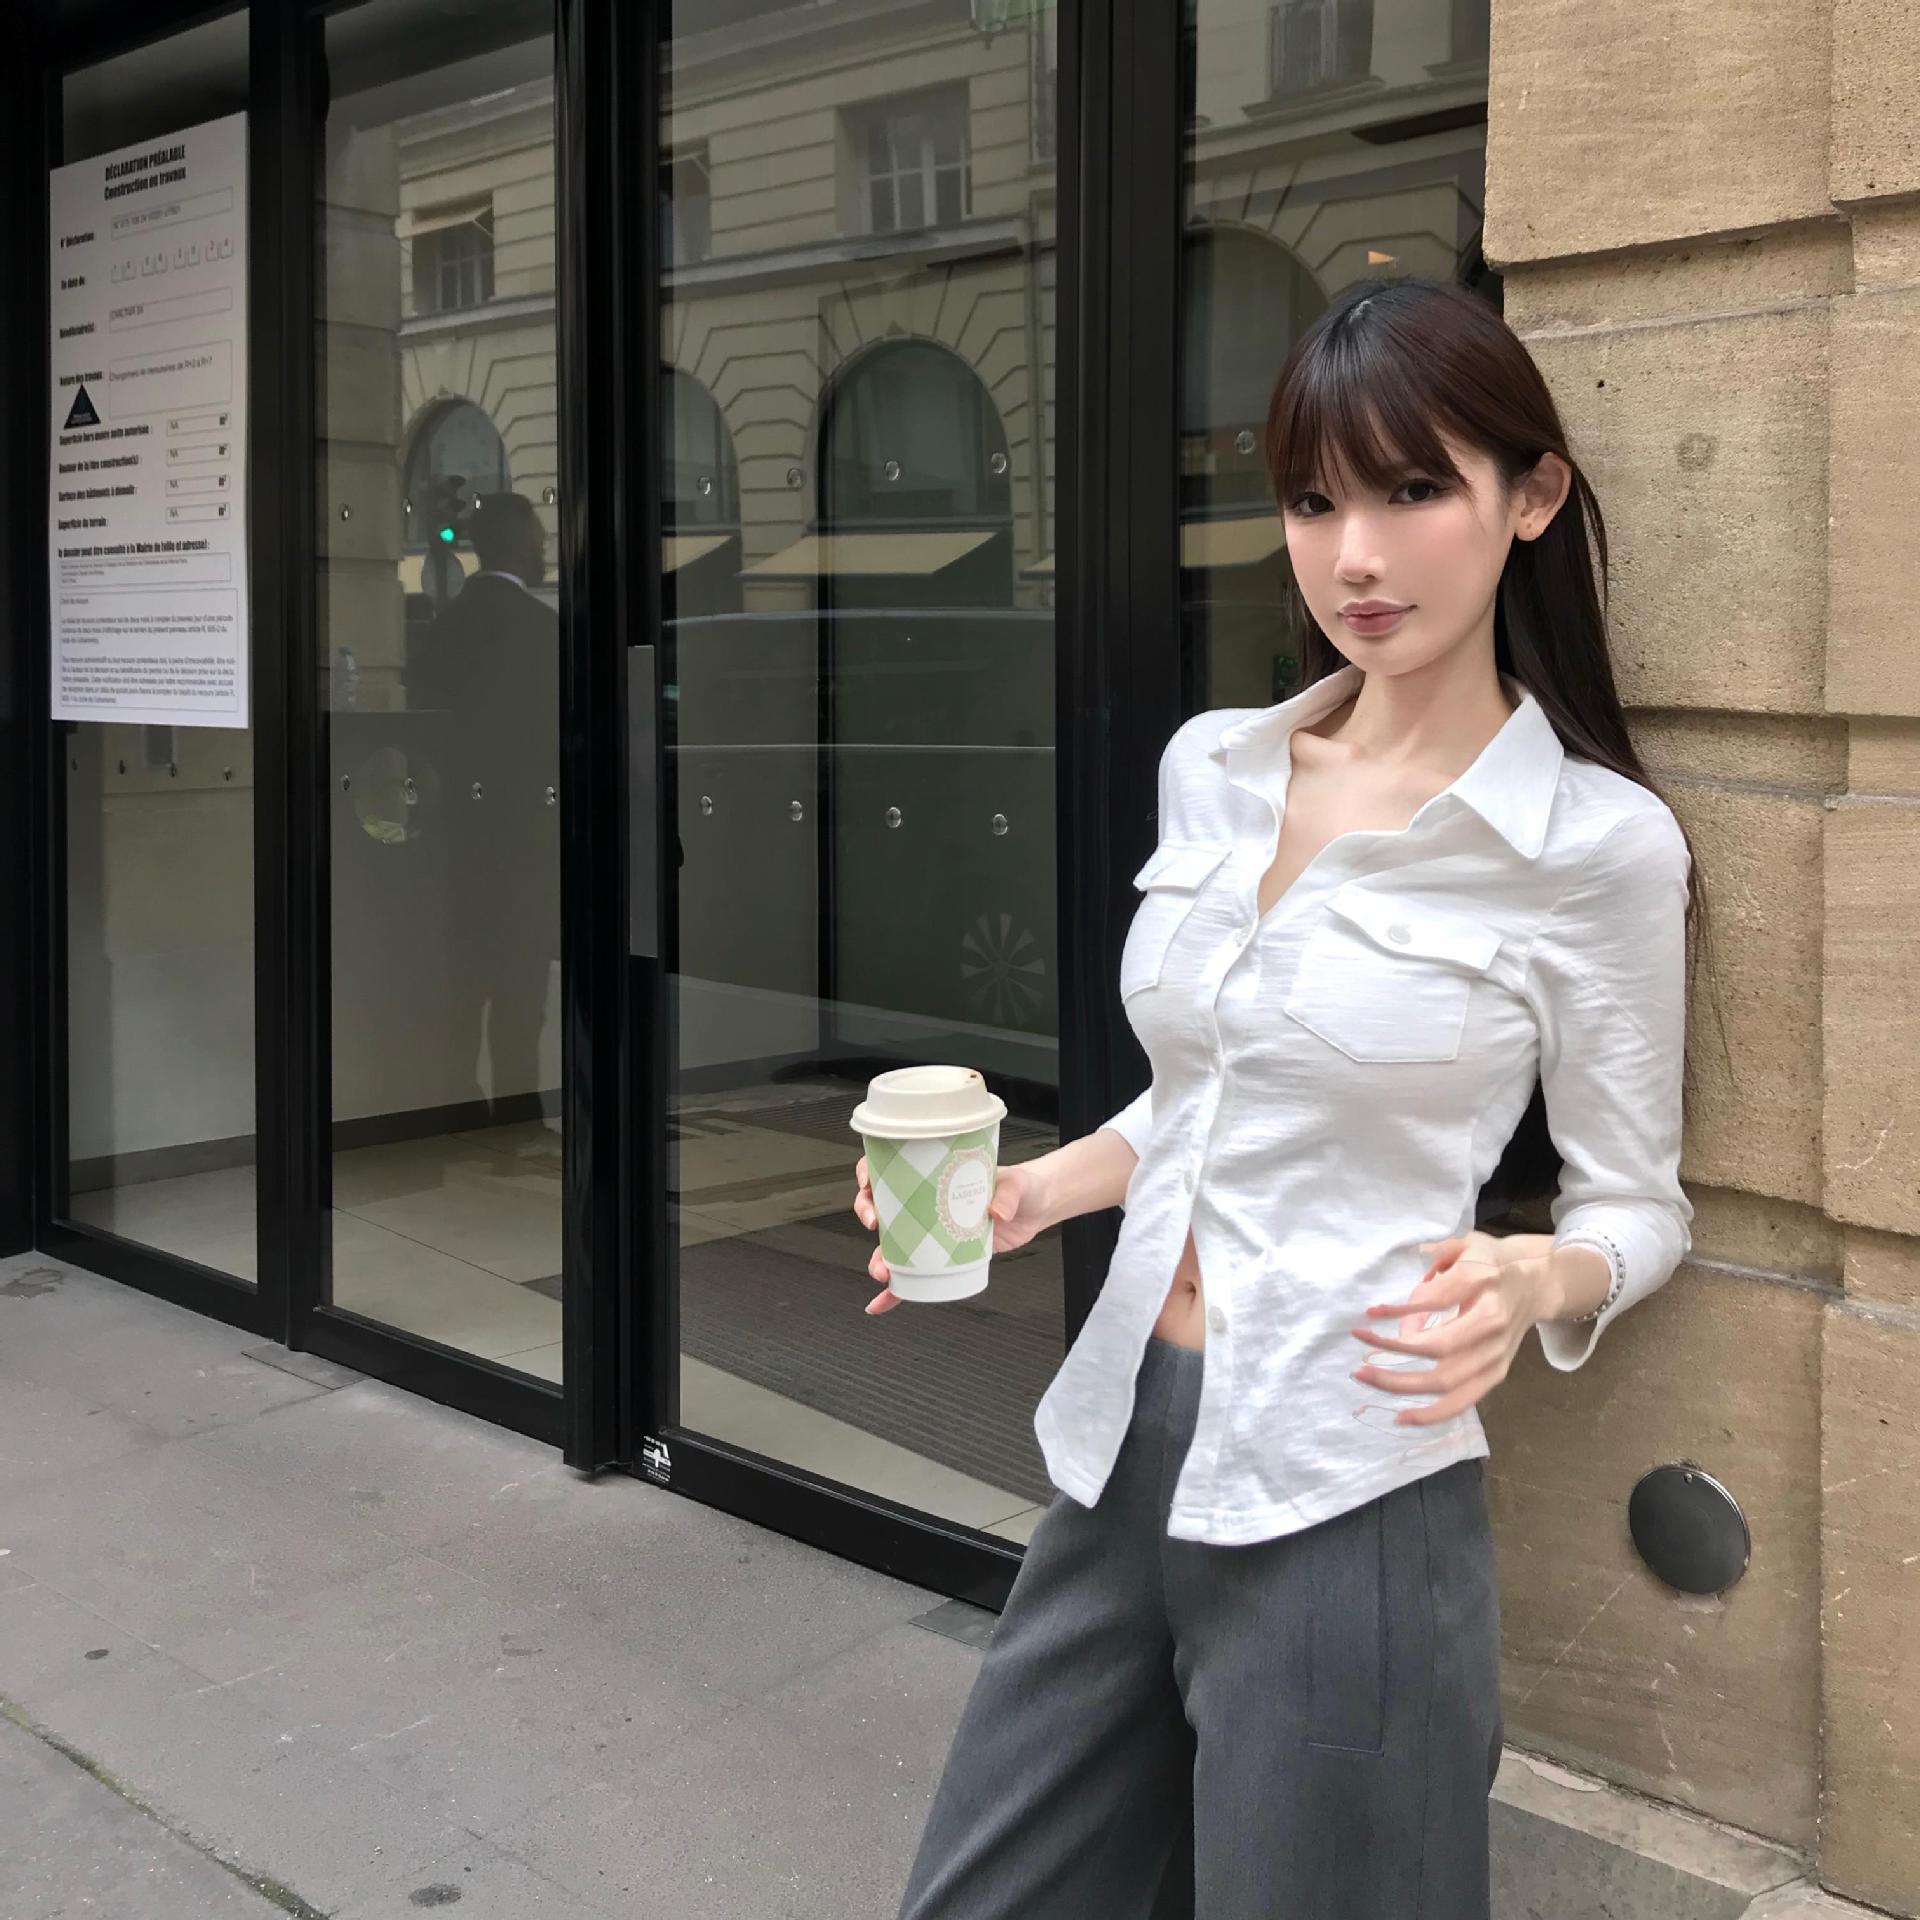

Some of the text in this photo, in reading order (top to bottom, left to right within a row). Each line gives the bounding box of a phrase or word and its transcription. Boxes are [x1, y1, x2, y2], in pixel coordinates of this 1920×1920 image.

[105, 144, 186, 181] DÉCLARATION PRÉALABLE
[104, 167, 186, 200] Construction ou travaux
